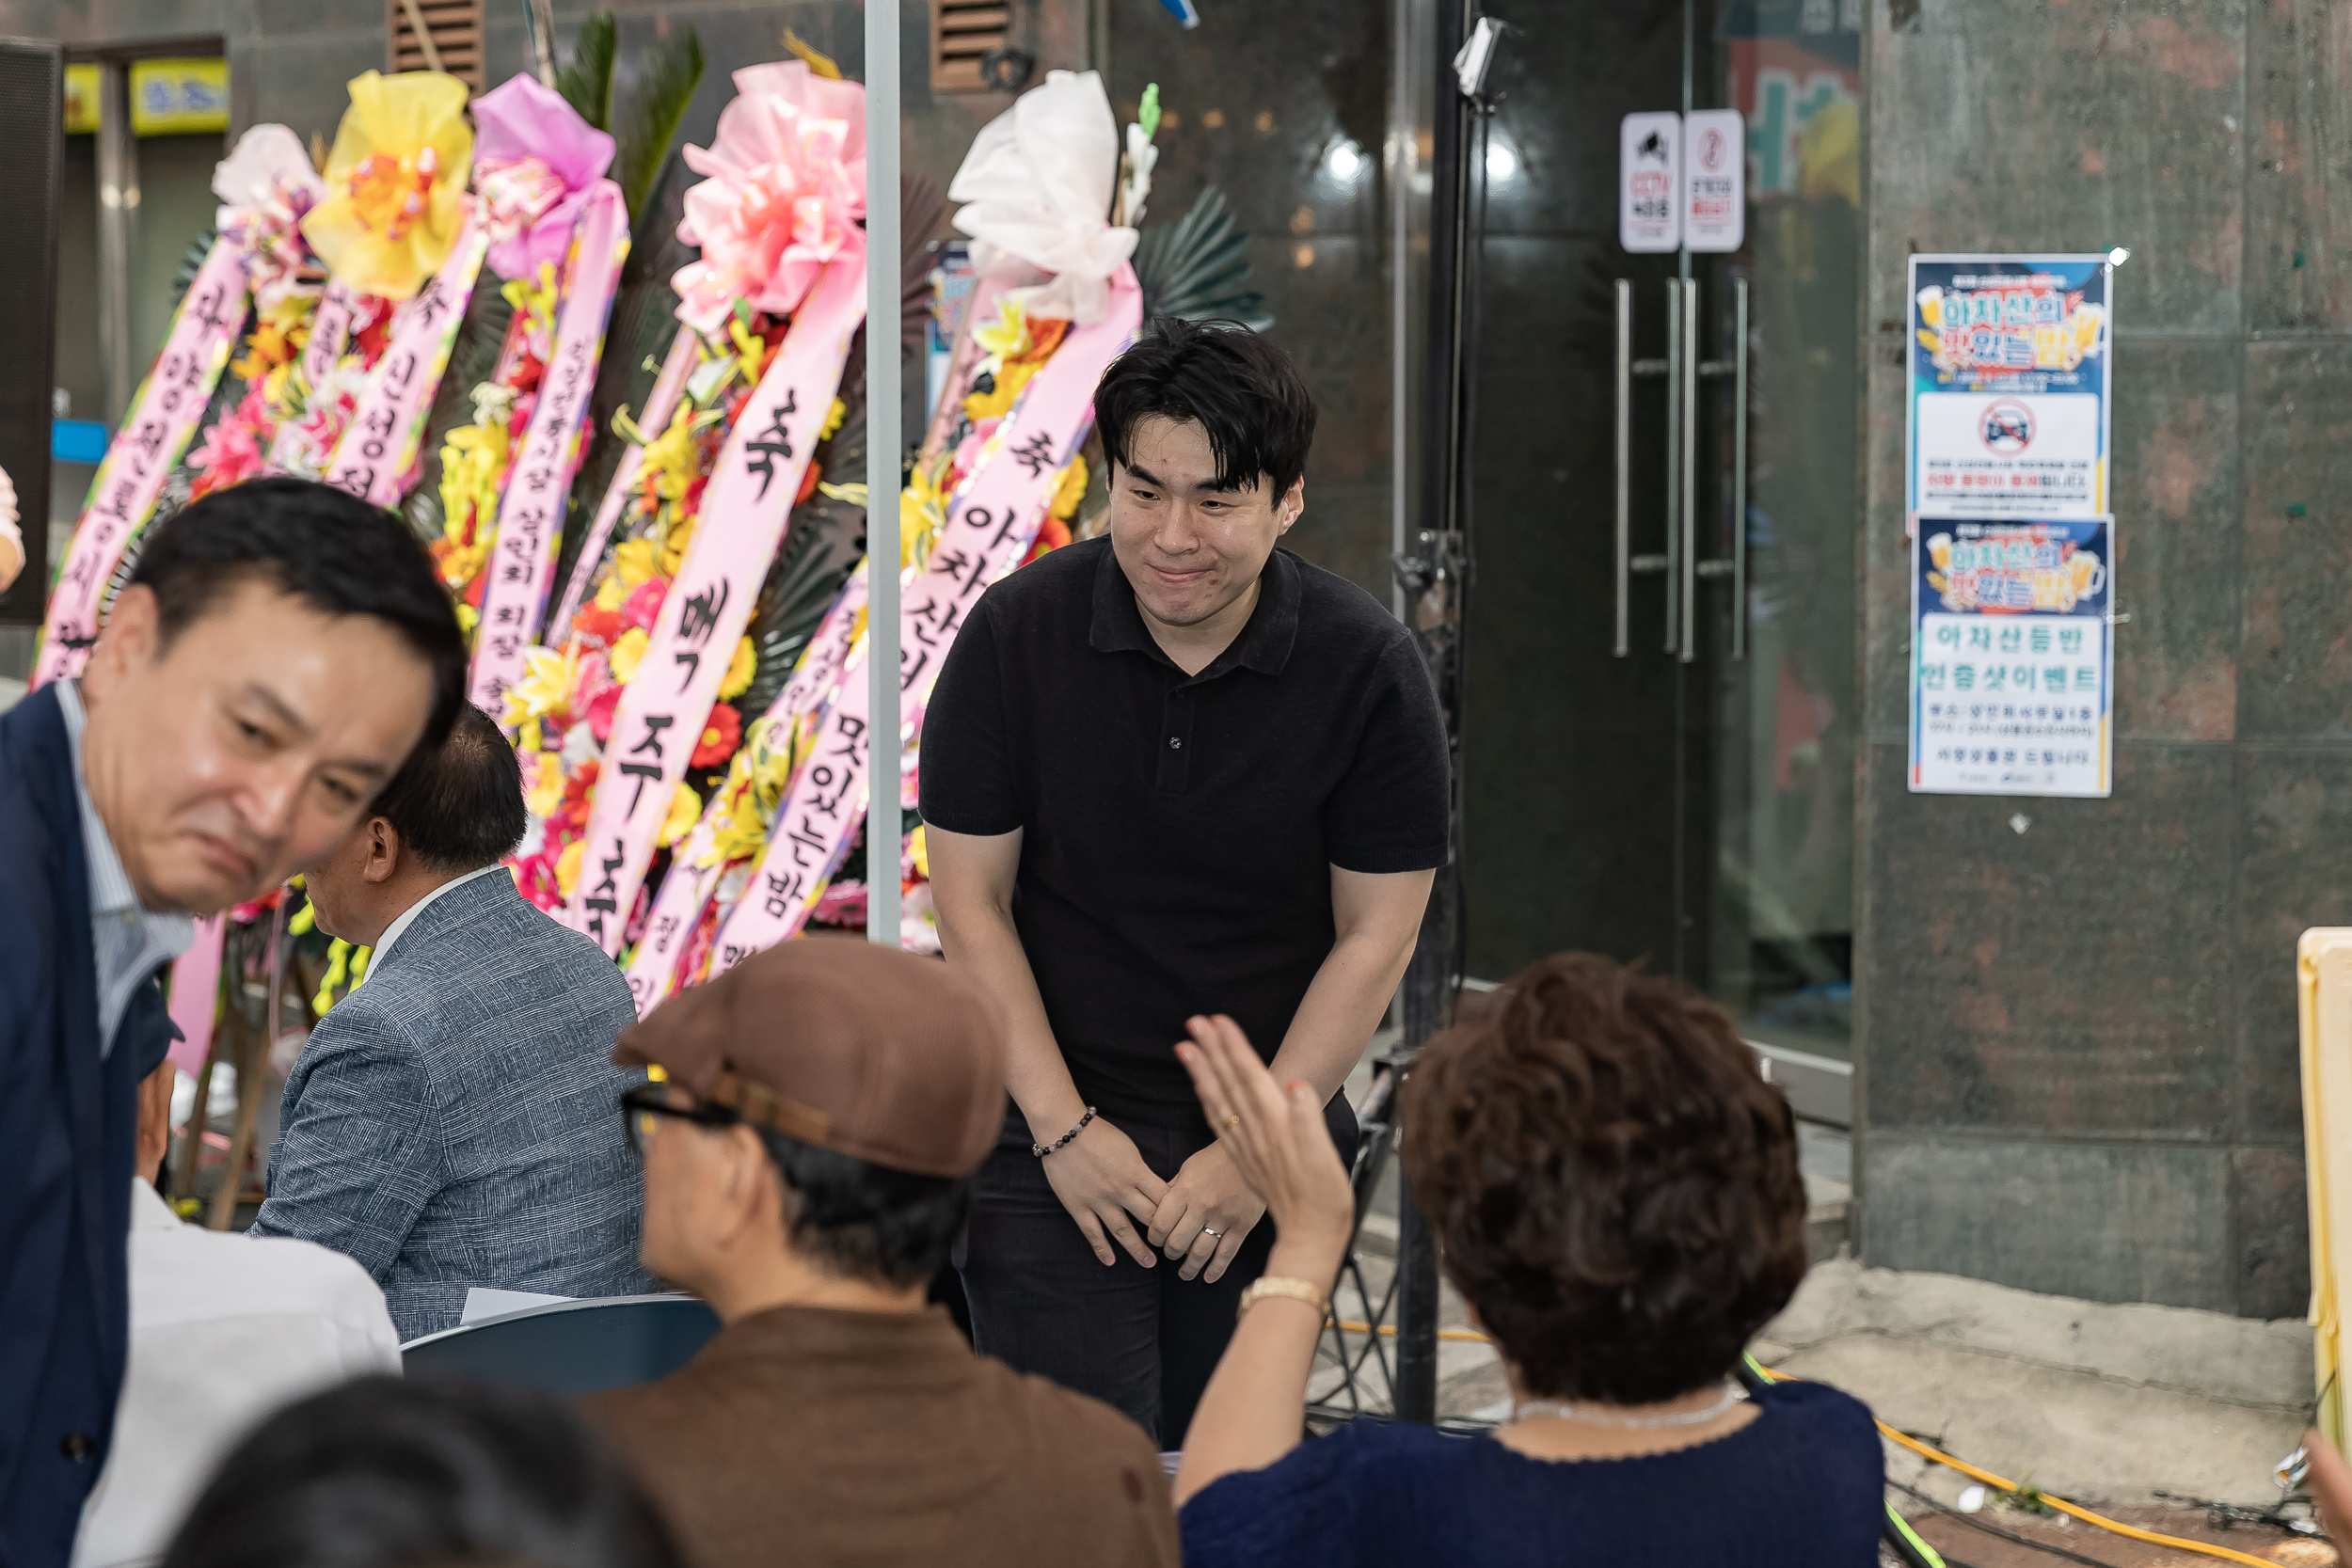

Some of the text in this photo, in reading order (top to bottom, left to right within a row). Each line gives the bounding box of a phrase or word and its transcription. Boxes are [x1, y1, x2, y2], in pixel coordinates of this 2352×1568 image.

[1944, 293, 2062, 326] 아차산의
[744, 388, 797, 502] 축
[1009, 429, 1056, 479] 축
[1951, 543, 2060, 570] 아차산의
[765, 873, 803, 918] 밤
